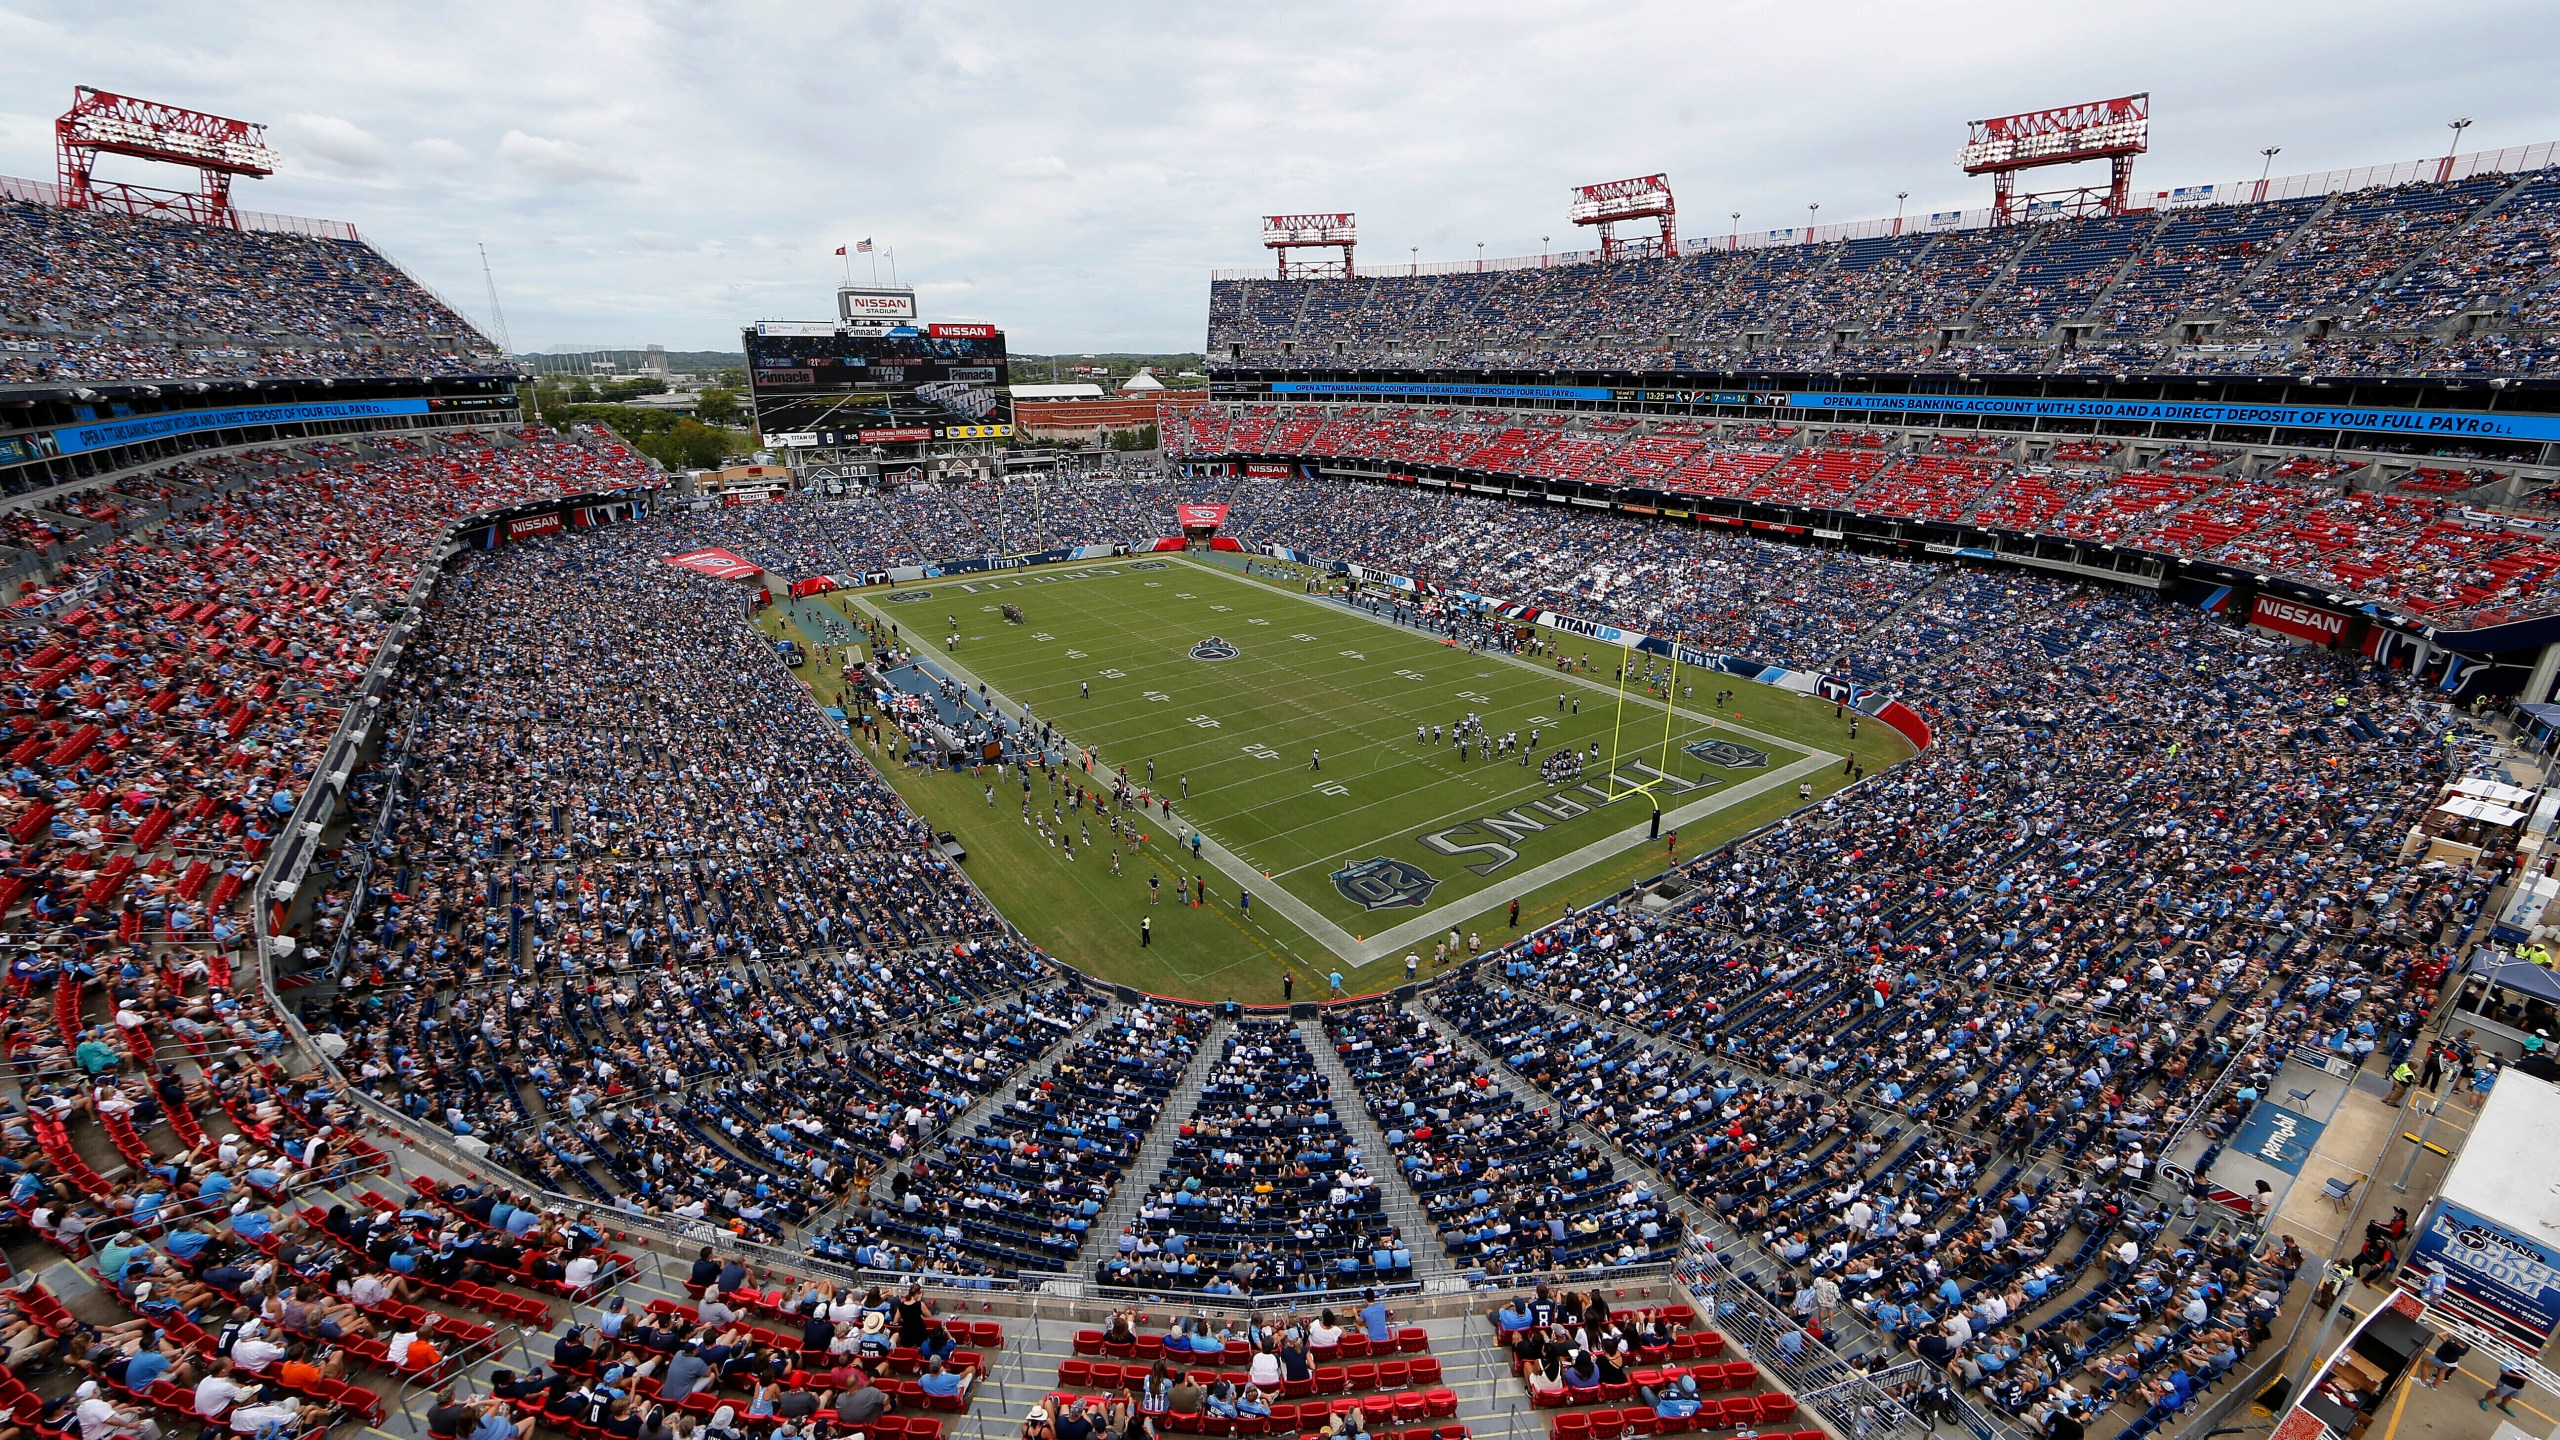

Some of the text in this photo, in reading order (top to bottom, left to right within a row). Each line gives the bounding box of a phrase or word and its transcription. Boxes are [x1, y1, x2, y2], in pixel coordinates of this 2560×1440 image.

[2184, 186, 2202, 195] KEN
[2172, 193, 2212, 203] HOUSTON
[2028, 207, 2059, 216] HOLOVAK
[855, 299, 907, 308] NISSAN
[848, 328, 882, 337] Pinnacle
[939, 327, 987, 335] NISSAN
[758, 370, 810, 383] Pinnacle
[951, 369, 993, 380] Pinnacle
[1376, 385, 1408, 393] ACCOUNT
[1441, 386, 1454, 394] AND
[1481, 387, 1506, 395] DEPOSIT
[1506, 388, 1515, 396] OF
[1517, 388, 1535, 396] YOUR
[1535, 388, 1550, 396] FULL
[1646, 392, 1665, 400] 13:25
[1715, 394, 1719, 402] 7
[1737, 394, 1746, 402] 14
[223, 411, 245, 425] DIRECT
[246, 408, 282, 422] DEPOSIT
[284, 407, 296, 419] OF
[296, 406, 323, 418] YOUR
[326, 405, 348, 416] FULL
[1823, 396, 2513, 434] OPEN A TITANS BANKING ACCOUNT WITH $100 AND A DIRECT DEPOSIT OF YOUR FULL PAYROLL
[1248, 465, 1288, 473] NISSAN
[511, 515, 559, 533] NISSAN
[1926, 544, 1953, 554] Pinnacle
[2257, 599, 2343, 634] NISSAN
[2260, 1113, 2298, 1162] permobil
[2478, 1226, 2540, 1261] TITANS
[2442, 1240, 2543, 1299] ROOM
[1538, 1311, 1548, 1327] 8
[591, 1404, 599, 1422] 8
